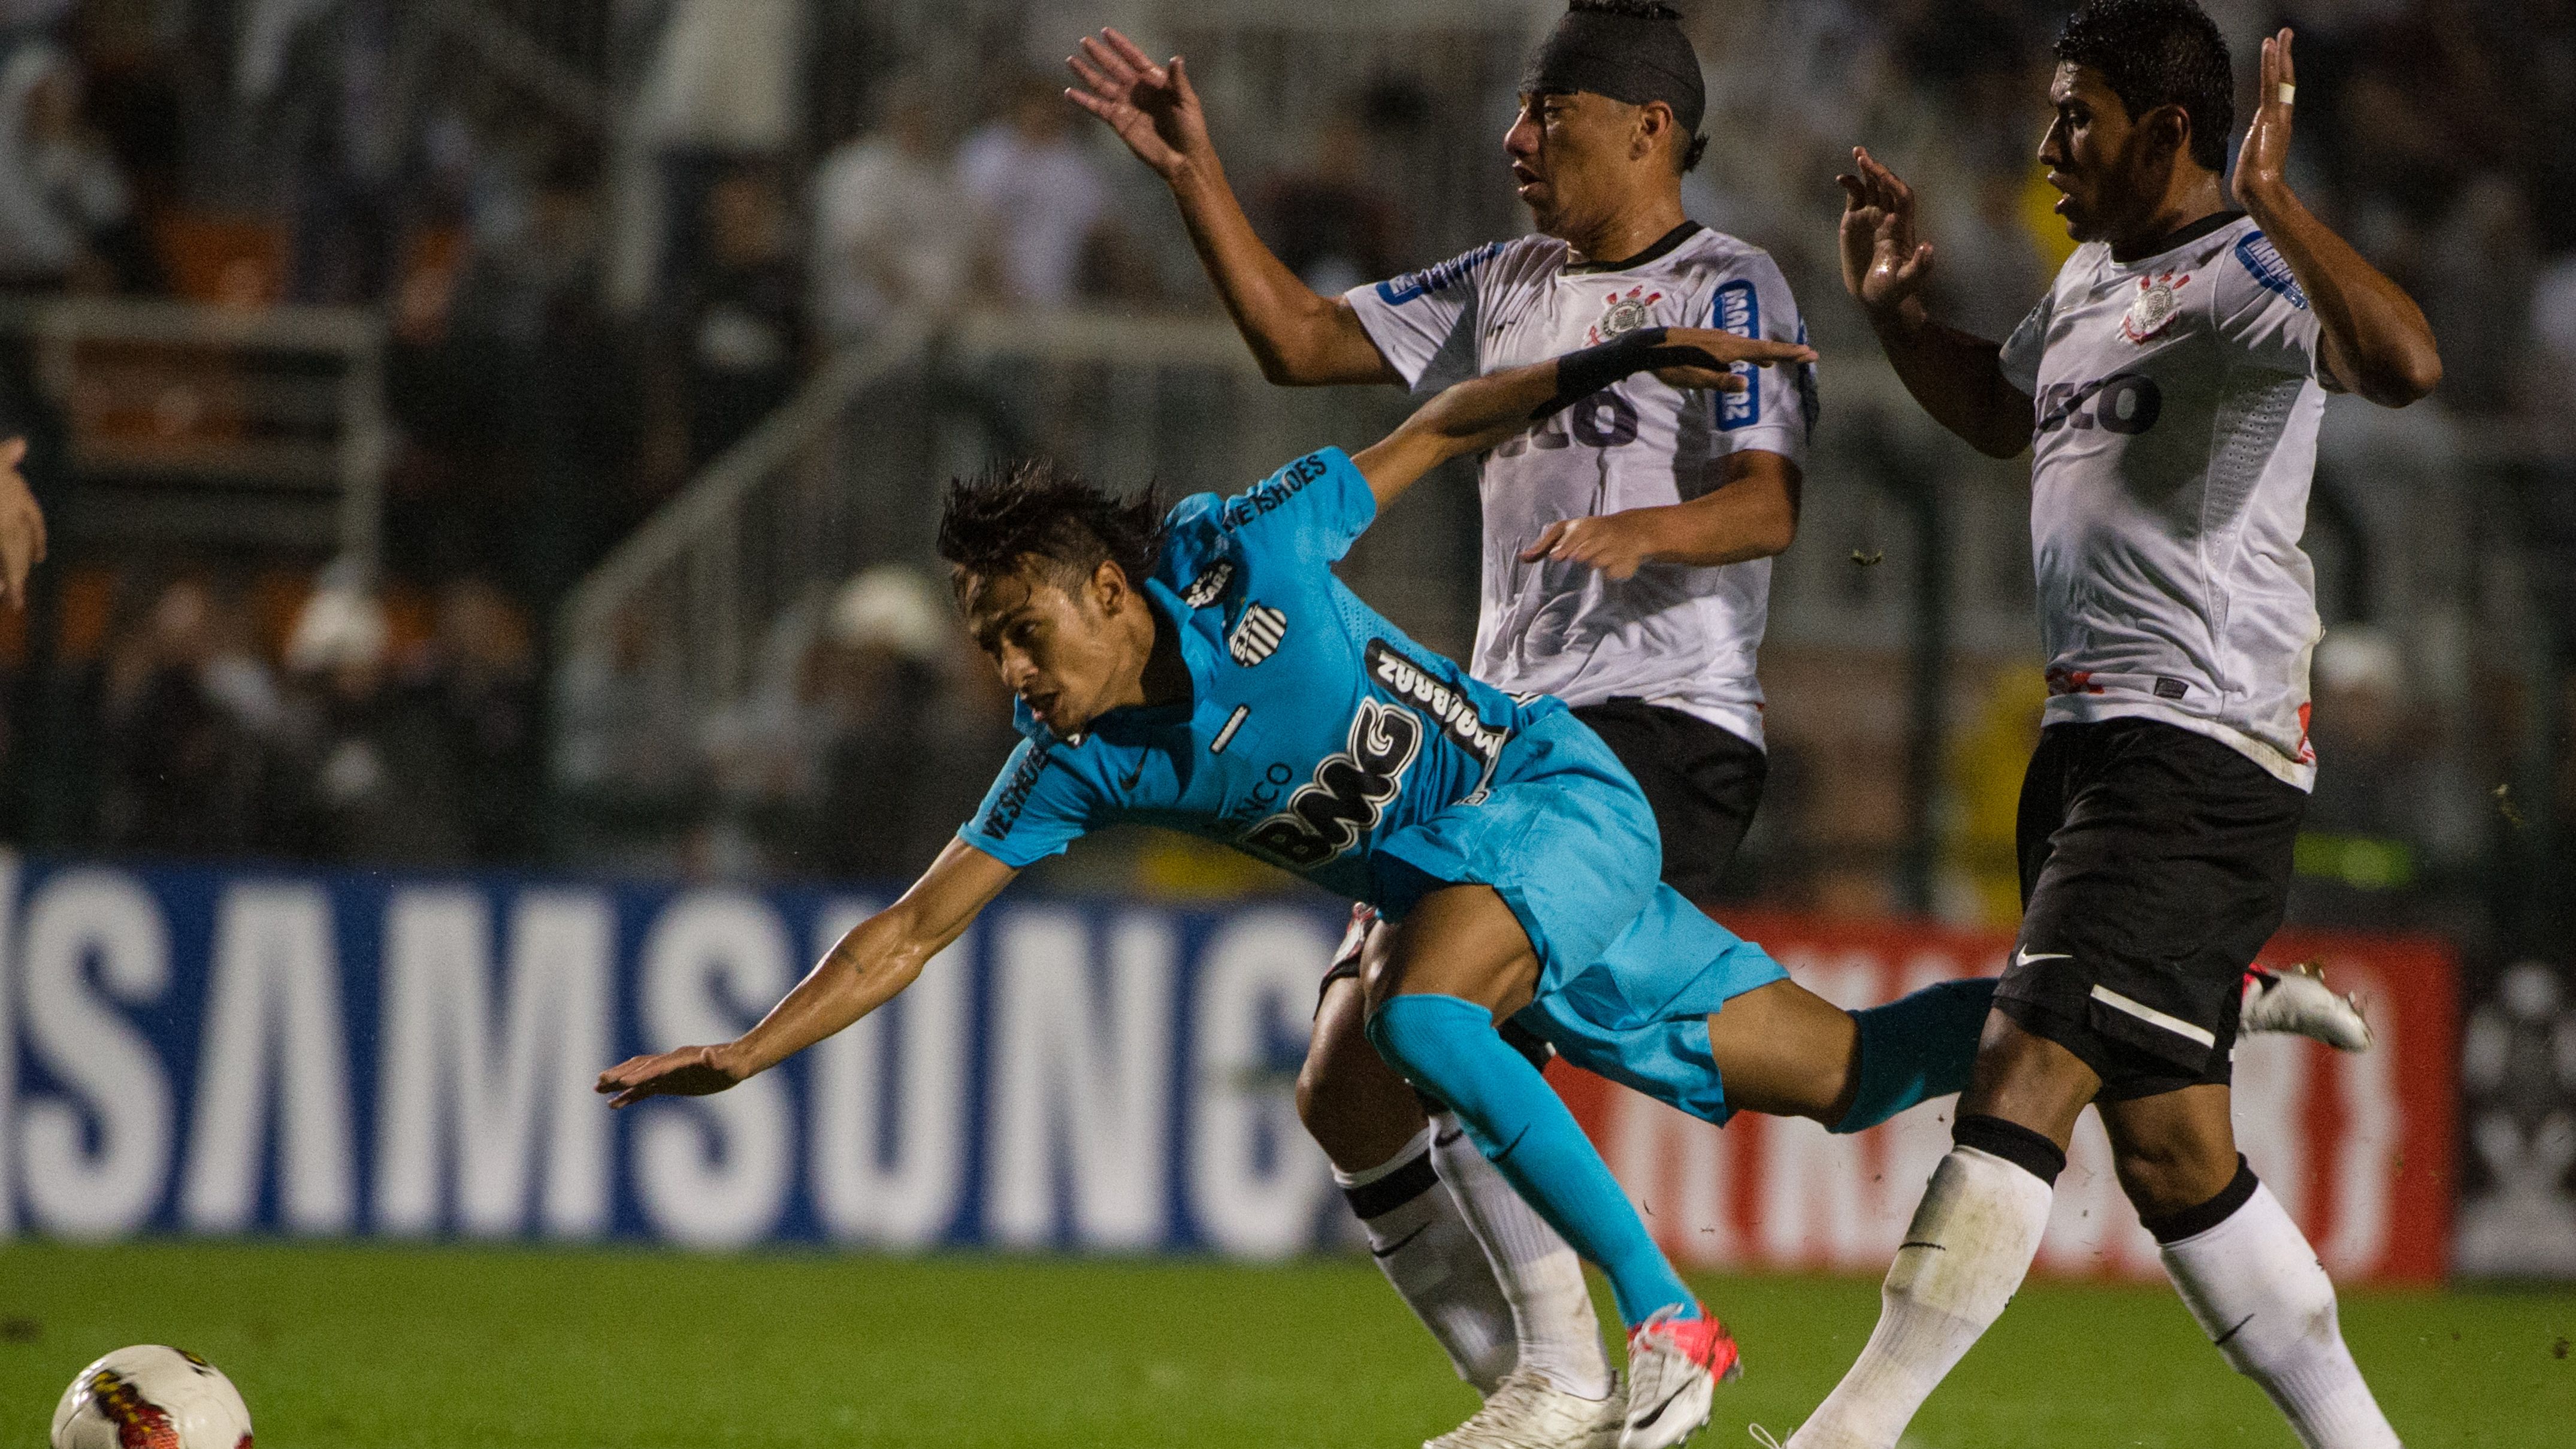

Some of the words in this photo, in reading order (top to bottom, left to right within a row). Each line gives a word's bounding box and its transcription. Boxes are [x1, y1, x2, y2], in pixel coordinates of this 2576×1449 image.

[1236, 695, 1423, 870] BMG
[1377, 650, 1505, 759] MABRAZ
[13, 867, 1339, 1259] SAMSUNG
